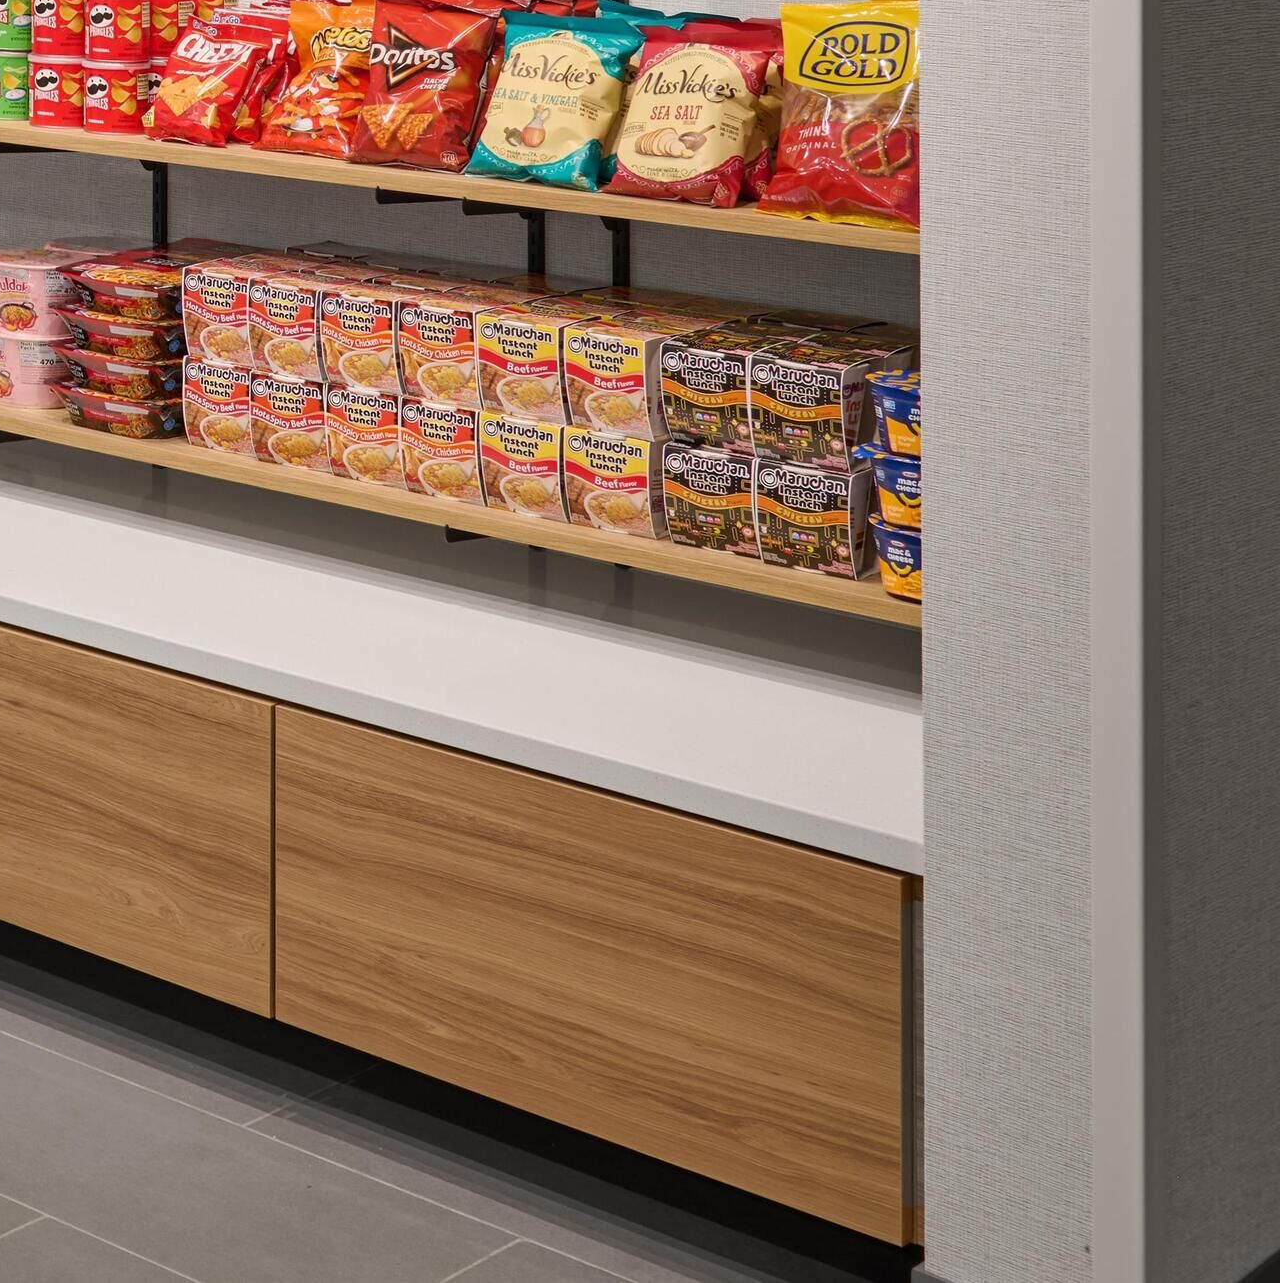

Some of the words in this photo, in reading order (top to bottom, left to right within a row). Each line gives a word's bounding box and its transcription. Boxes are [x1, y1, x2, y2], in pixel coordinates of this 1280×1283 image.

[34, 16, 57, 29] PRINGLES
[90, 25, 115, 39] PRINGLES
[819, 32, 901, 58] ROLD
[370, 43, 456, 72] Doritos
[539, 55, 599, 90] Vickie's
[810, 57, 898, 81] GOLD
[419, 82, 447, 91] CHEESE
[424, 76, 450, 85] NACHO
[639, 69, 678, 97] Miss
[679, 64, 739, 102] Vickie's
[35, 88, 59, 103] PRINGLES
[86, 97, 109, 110] PRINGLES
[508, 90, 530, 100] SALT
[530, 94, 538, 103] &
[542, 94, 578, 107] VINEGAR
[650, 105, 671, 120] SEA
[674, 104, 703, 120] SALT
[798, 125, 830, 141] THINS
[786, 141, 837, 154] ORIGINAL
[197, 275, 247, 293] Maruchan
[262, 286, 314, 306] Maruchan
[265, 300, 298, 313] Instant
[335, 298, 390, 317] Maruchan
[268, 309, 295, 321] Lunch
[413, 308, 471, 328] Maruchan
[284, 321, 299, 330] Beef
[493, 322, 552, 342] Maruchan
[580, 337, 639, 357] Maruchan
[584, 351, 625, 365] Instant
[678, 352, 744, 376] Maruchan
[197, 364, 249, 383] Maruchan
[506, 361, 530, 374] Beef
[589, 360, 620, 373] Lunch
[681, 368, 726, 384] Instant
[768, 365, 838, 390] Maruchan
[265, 380, 321, 399] Maruchan
[688, 379, 724, 392] Lunch
[268, 393, 305, 406] Instant
[340, 391, 396, 411] Maruchan
[272, 402, 302, 414] Lunch
[344, 405, 381, 418] Instant
[414, 405, 473, 427] Maruchan
[348, 414, 377, 426] Lunch
[419, 419, 457, 434] Instant
[360, 430, 385, 439] Chicken
[423, 428, 453, 442] Lunch
[495, 421, 553, 443] Maruchan
[581, 435, 643, 457] Maruchan
[585, 449, 627, 465] Instant
[590, 459, 623, 474] Lunch
[680, 454, 750, 478] Maruchan
[595, 475, 619, 489] Beef
[619, 480, 637, 488] Flavor
[774, 470, 846, 495] Maruchan
[779, 486, 828, 502] Instant
[784, 496, 822, 511] Lunch
